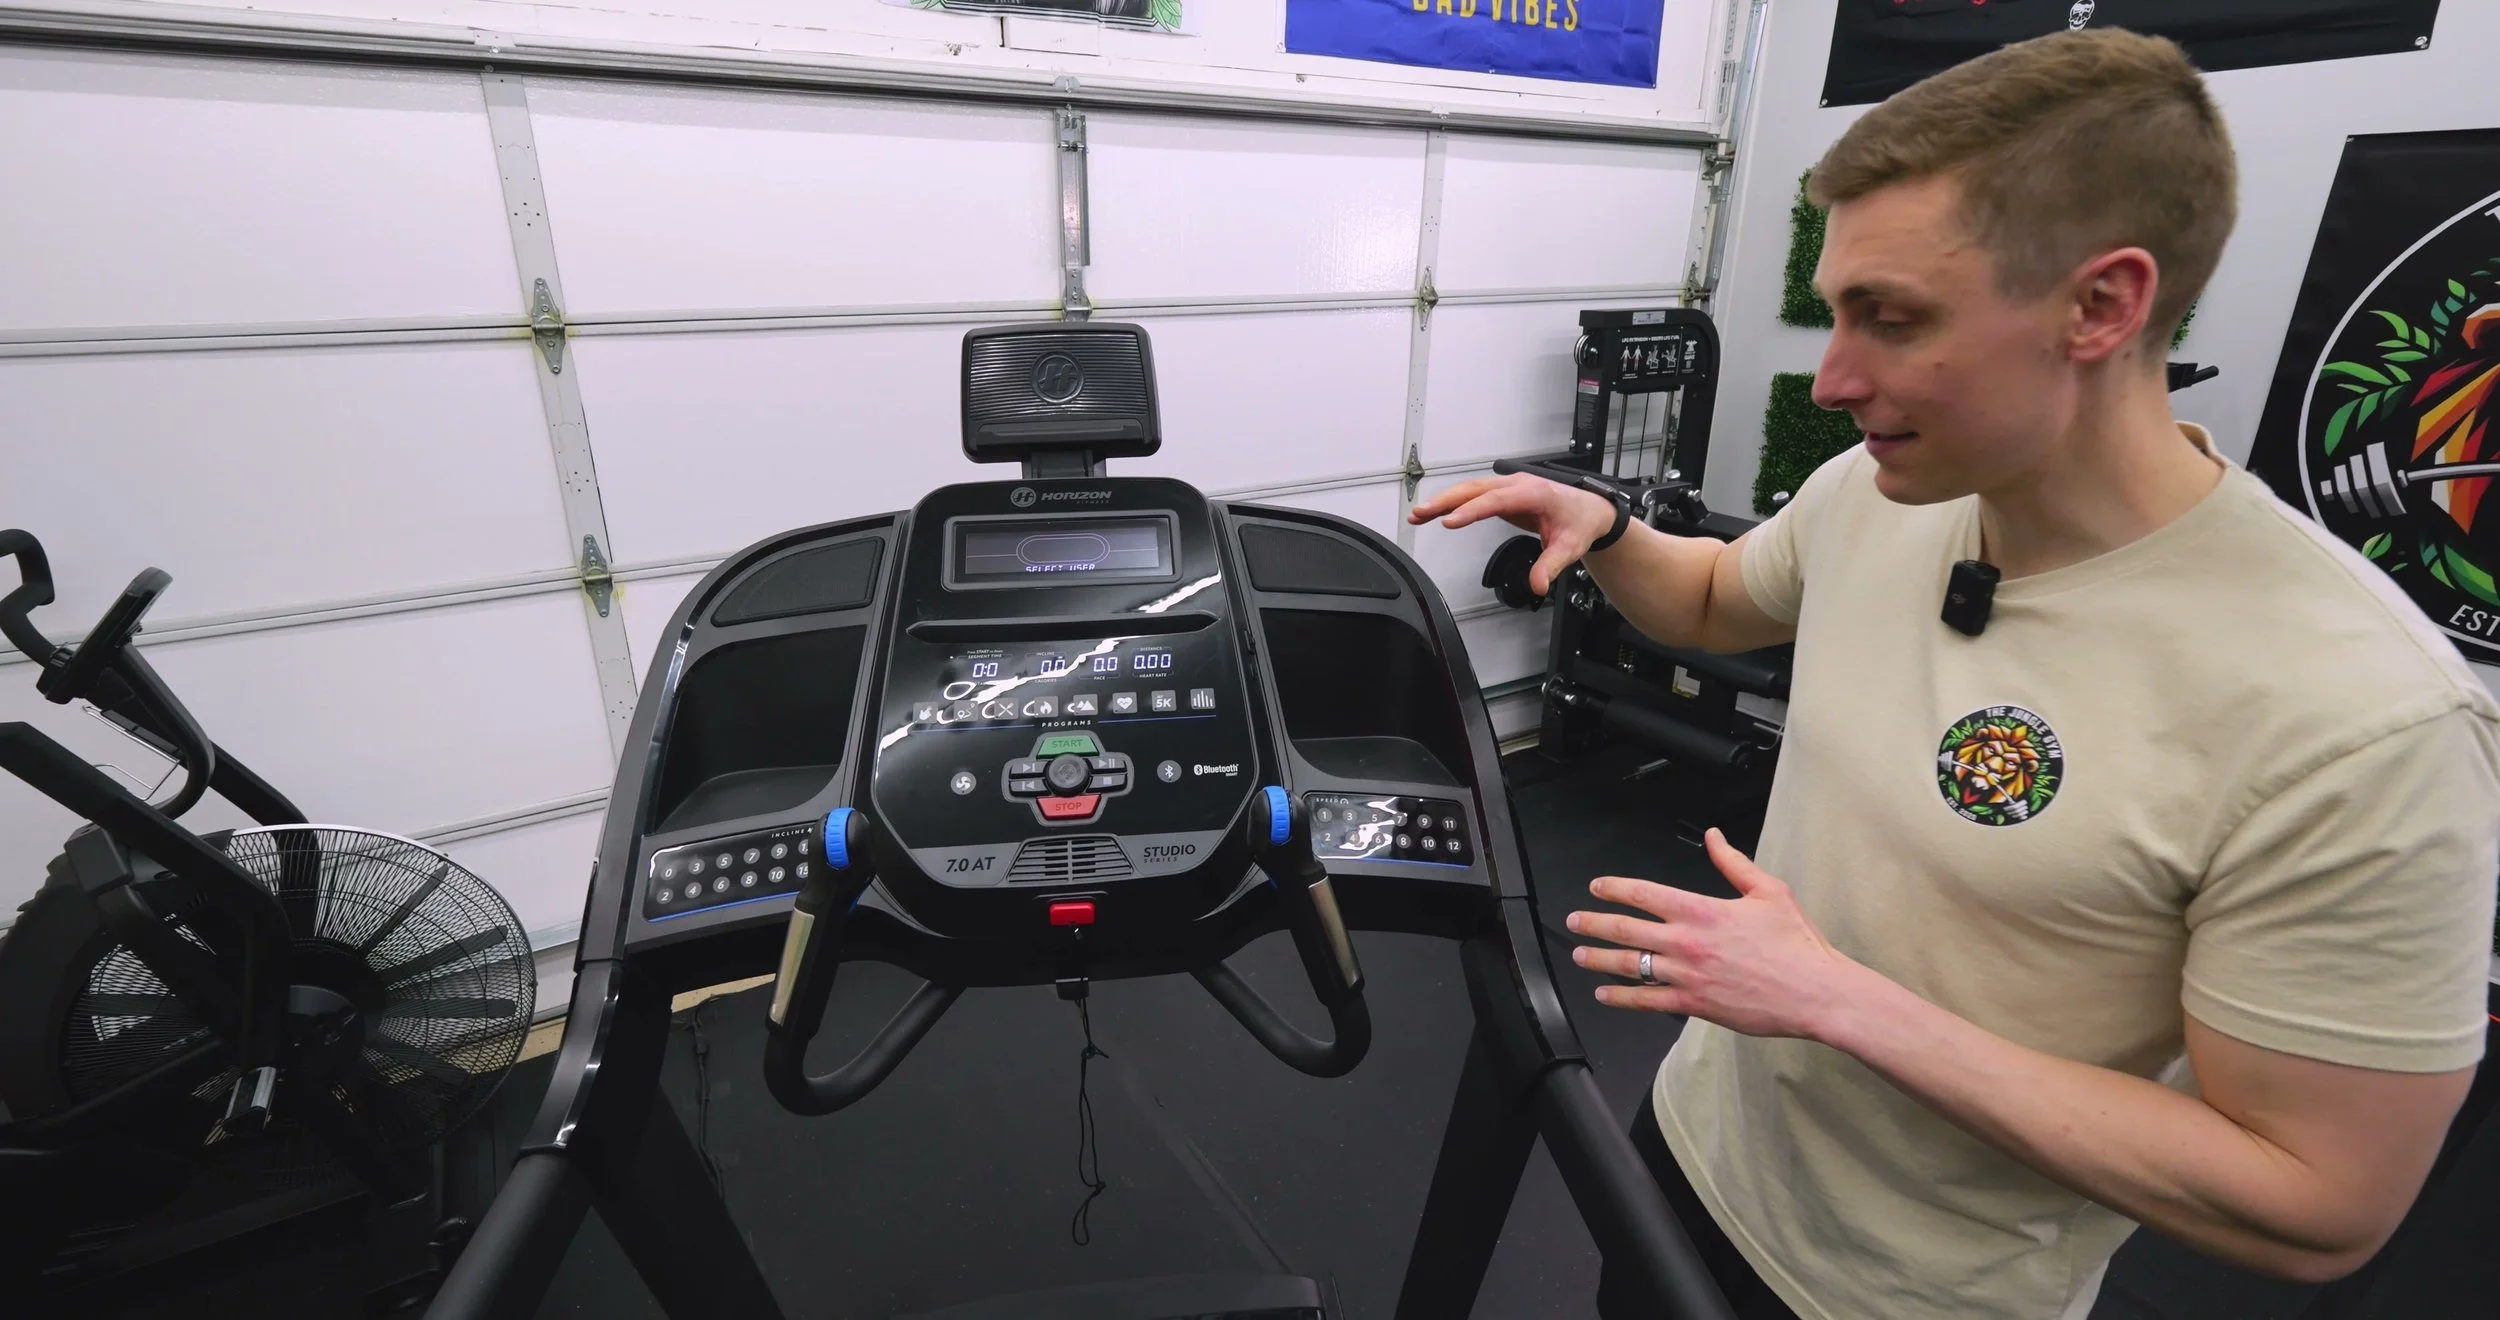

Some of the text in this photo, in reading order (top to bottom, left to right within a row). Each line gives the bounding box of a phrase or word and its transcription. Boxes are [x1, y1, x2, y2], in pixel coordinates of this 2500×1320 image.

[1492, 0, 1579, 32] VIBES
[1041, 491, 1112, 501] HORIZON
[1156, 697, 1172, 708] 5K
[1042, 720, 1091, 728] PROGRAMS
[1985, 707, 2006, 718] THE
[2008, 708, 2049, 735] JUNGLE
[1051, 739, 1083, 749] START
[1203, 763, 1238, 774] Bluetooth
[1055, 802, 1082, 812] STOP
[1322, 811, 1454, 828] 1 3 5 7 9 11
[771, 829, 804, 838] INCLINE
[1325, 832, 1459, 850] 2 4 6 8 10 12
[1143, 844, 1196, 858] STUDIO
[665, 868, 672, 878] 0
[693, 863, 700, 872] 3
[721, 857, 728, 866] 5
[749, 852, 756, 861] 7
[776, 847, 784, 857] 9
[946, 856, 996, 873] 7.0 AT
[661, 892, 669, 901] 2
[689, 886, 697, 895] 4
[717, 880, 725, 889] 6
[745, 875, 753, 884] 8
[771, 870, 783, 880] 10
